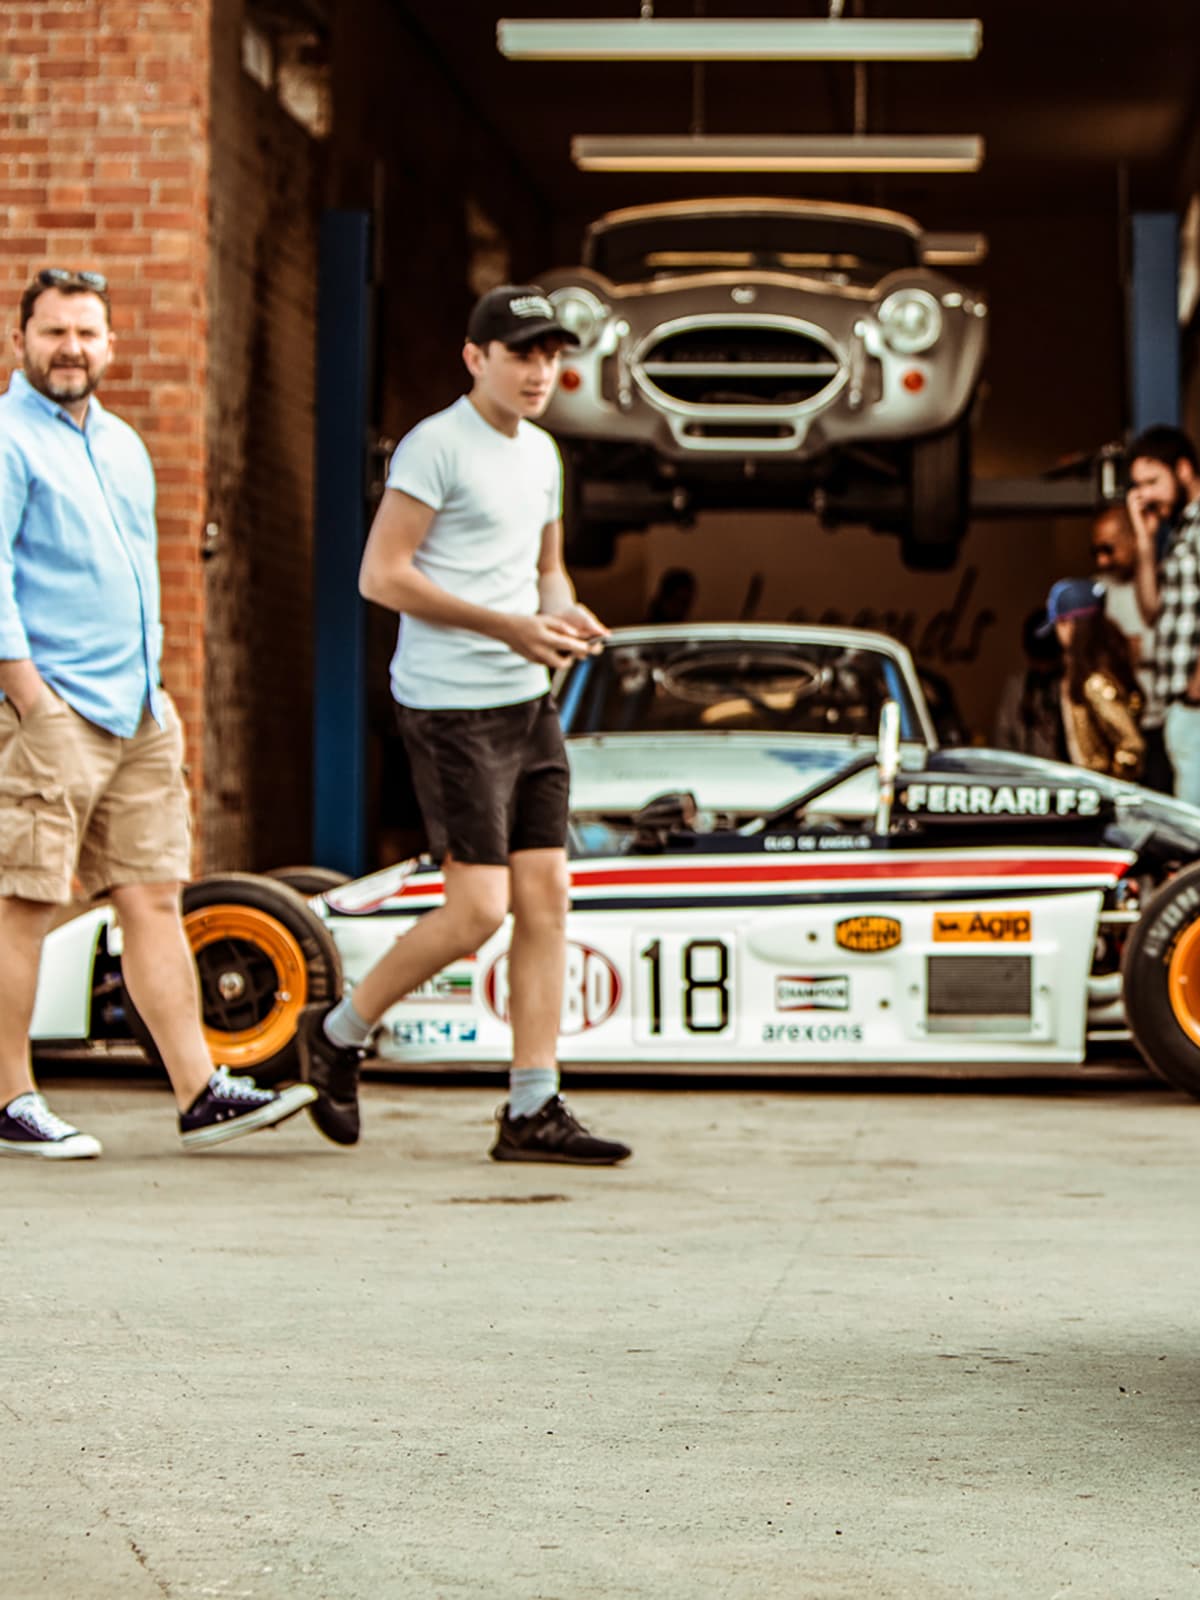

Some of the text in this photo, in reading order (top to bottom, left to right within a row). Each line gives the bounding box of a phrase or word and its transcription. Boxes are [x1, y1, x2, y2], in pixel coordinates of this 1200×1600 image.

[906, 784, 1100, 816] FERRARI F2
[968, 912, 1031, 940] Agip
[641, 939, 729, 1036] 18
[778, 984, 847, 1000] CHAMPION
[762, 1023, 863, 1042] arexons
